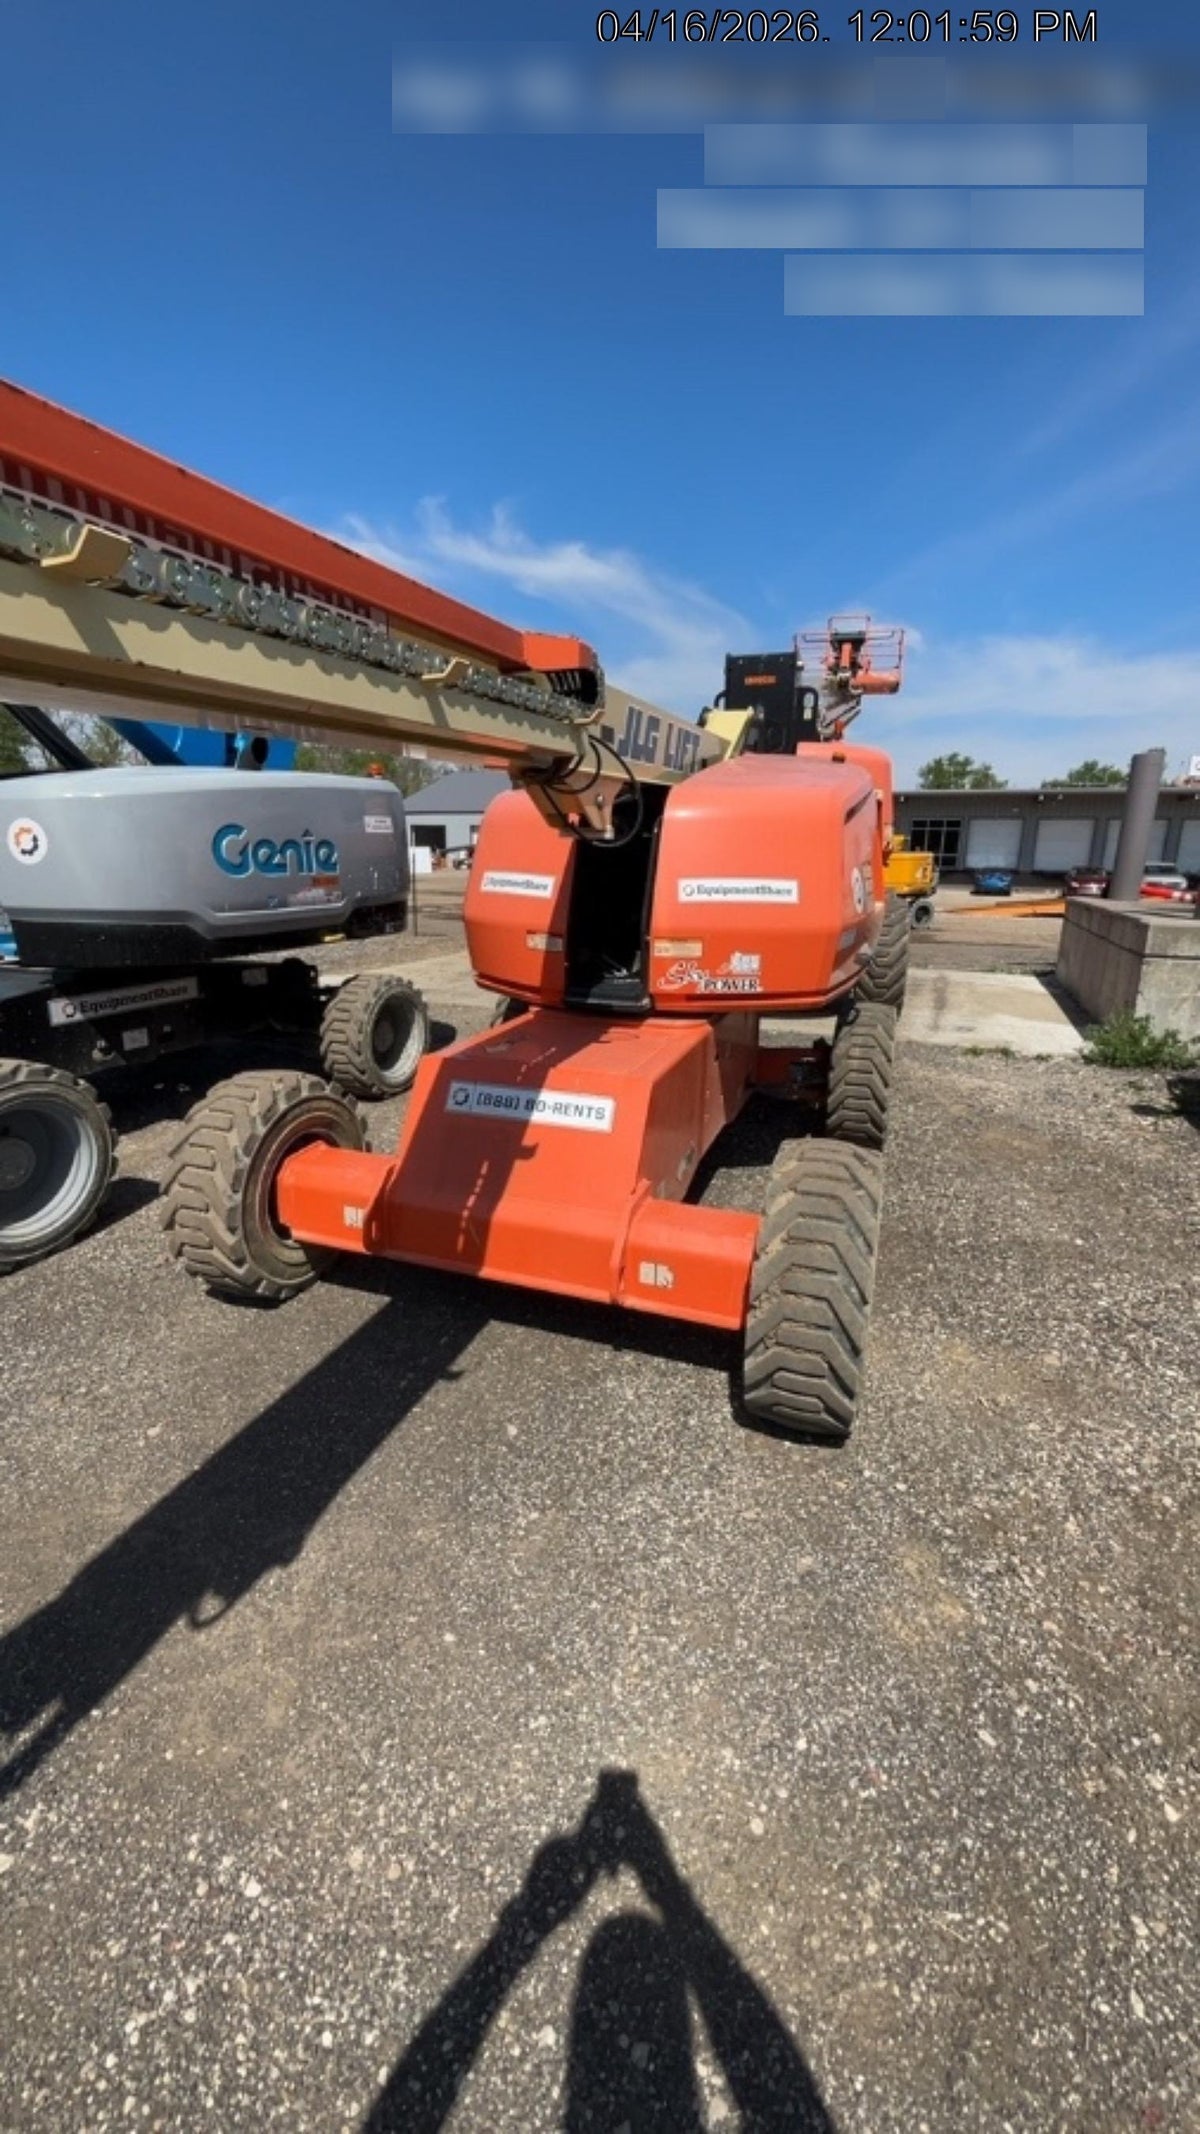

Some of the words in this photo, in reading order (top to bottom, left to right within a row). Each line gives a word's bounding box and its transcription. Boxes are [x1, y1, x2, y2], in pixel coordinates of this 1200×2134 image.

[617, 706, 660, 764] JLG
[663, 722, 700, 773] LIFT
[212, 823, 340, 878] Genie
[696, 884, 793, 896] EquipmentShare
[702, 977, 762, 993] POWER
